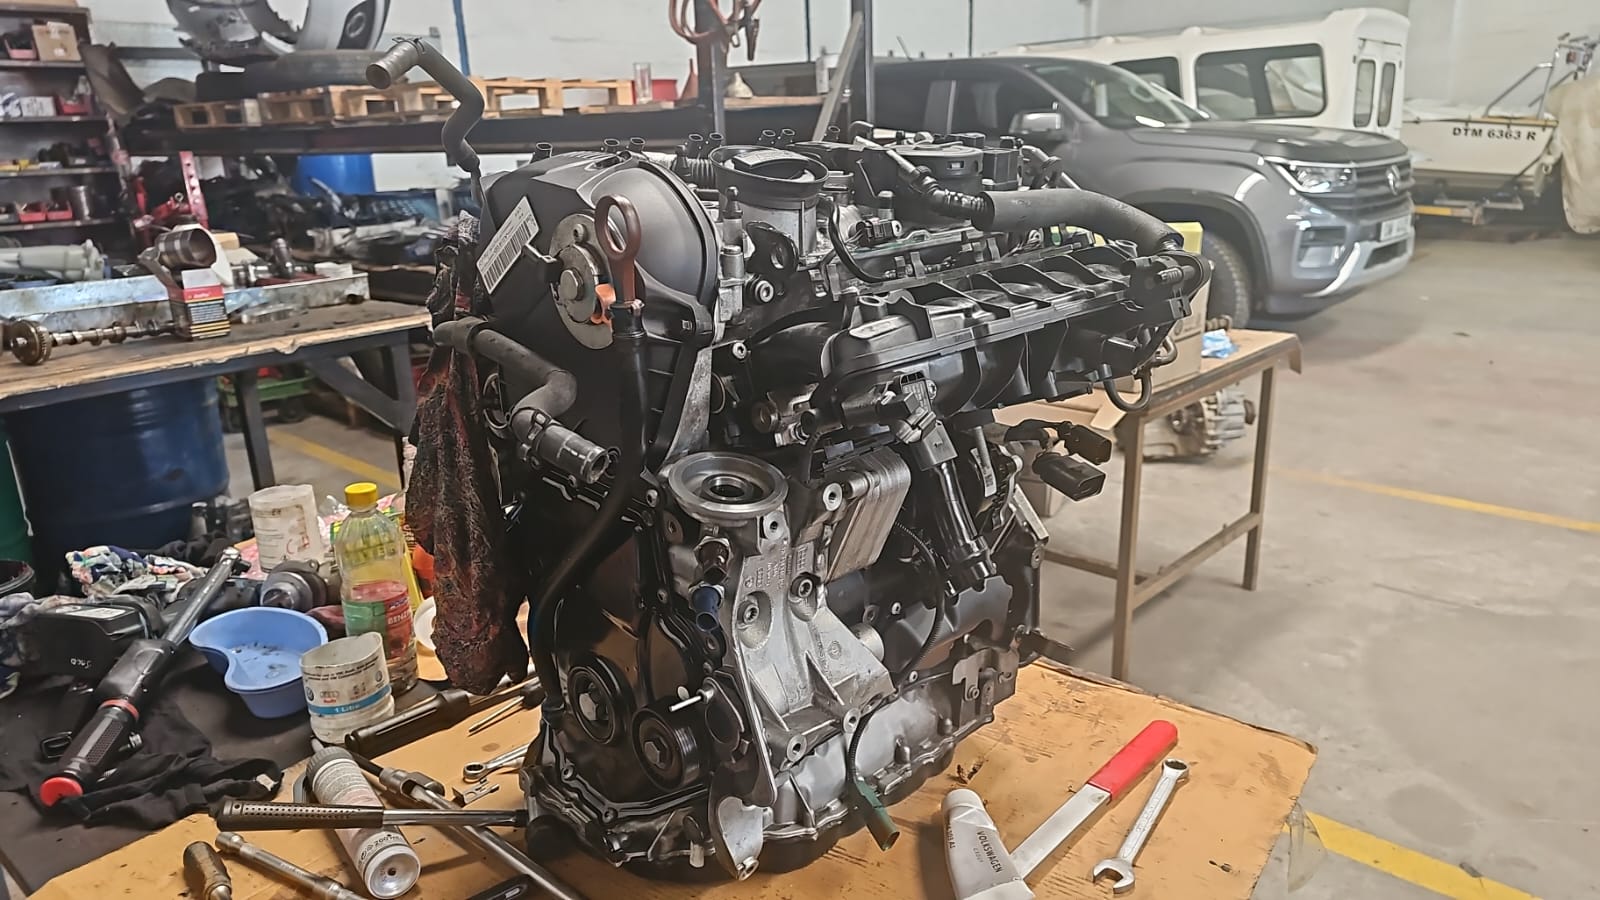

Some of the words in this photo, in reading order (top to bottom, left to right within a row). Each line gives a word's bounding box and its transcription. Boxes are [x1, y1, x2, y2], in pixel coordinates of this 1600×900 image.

[1452, 127, 1483, 137] DTM
[1487, 128, 1521, 140] 6363
[1526, 131, 1537, 141] R
[976, 830, 1003, 873] VOLKSWAGEN
